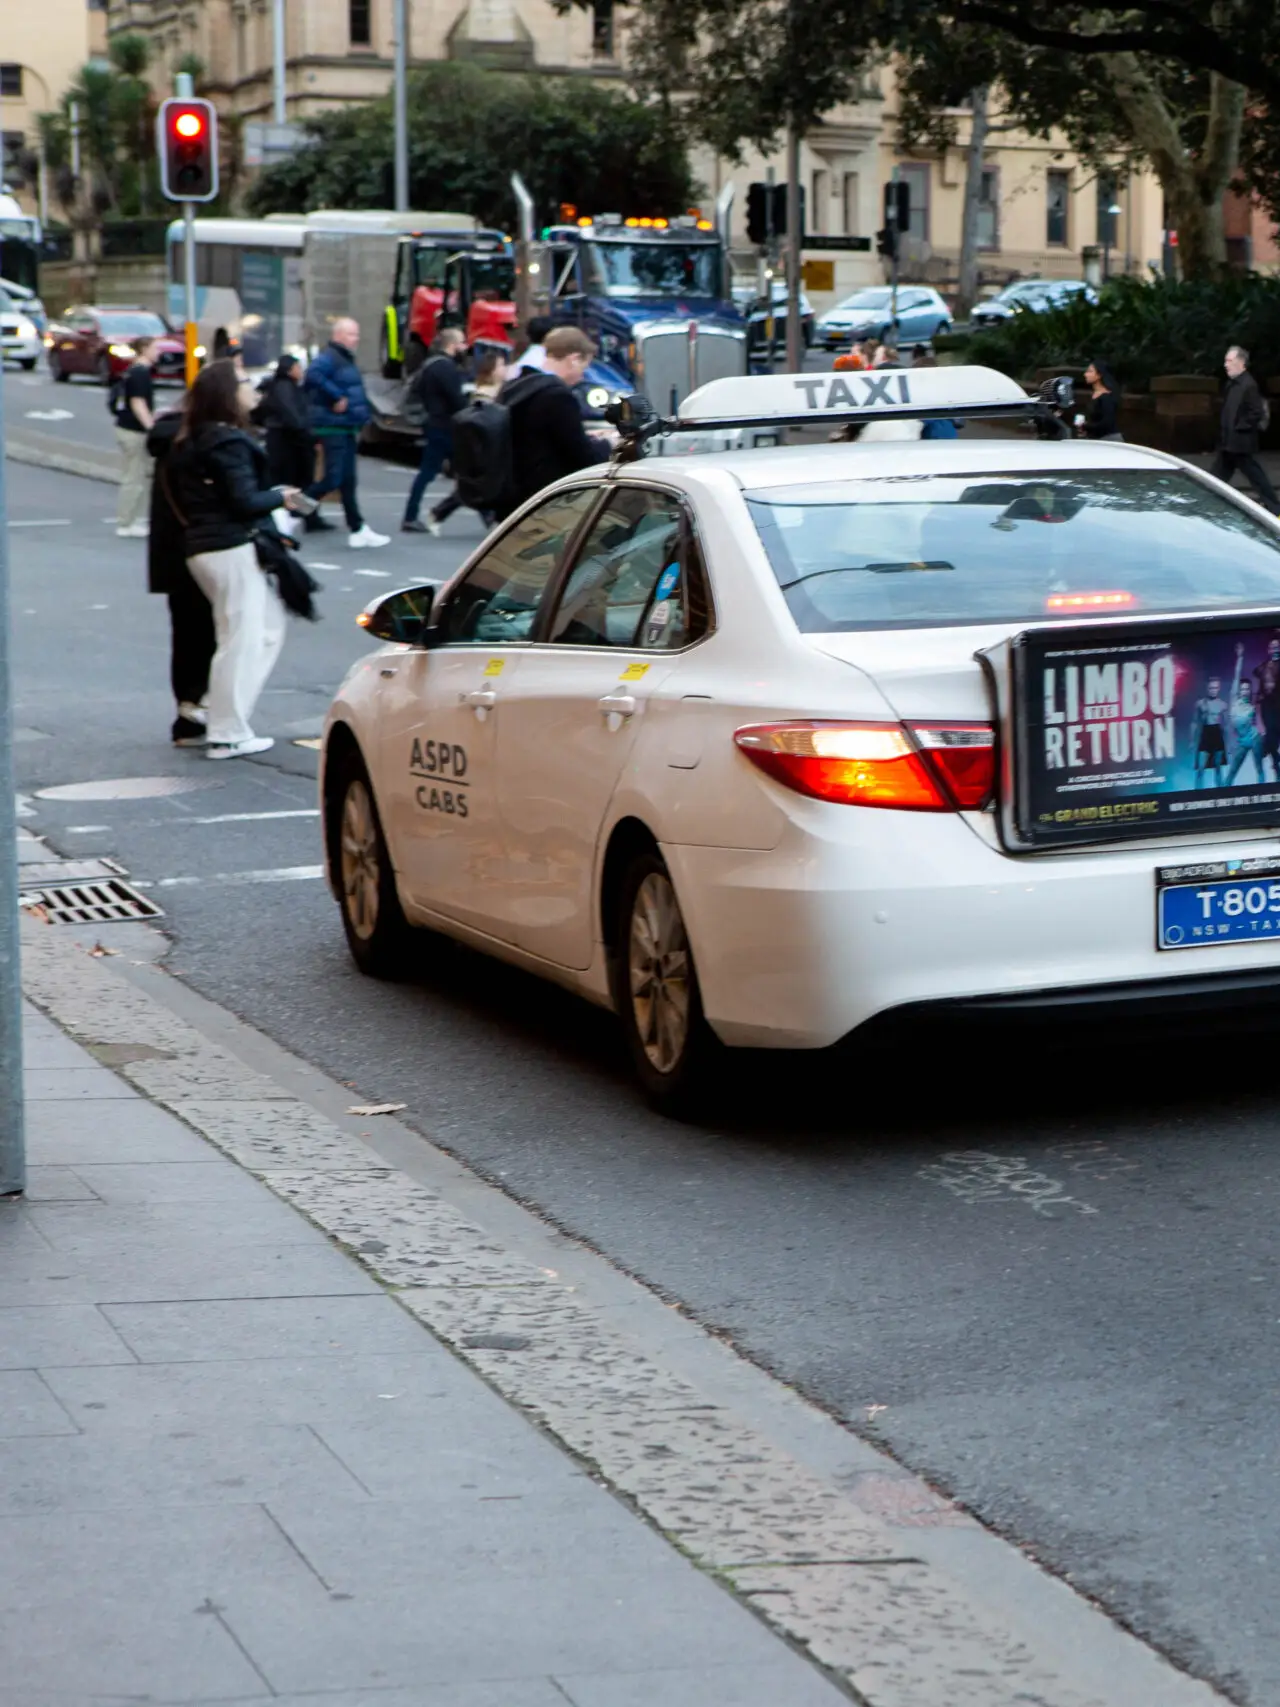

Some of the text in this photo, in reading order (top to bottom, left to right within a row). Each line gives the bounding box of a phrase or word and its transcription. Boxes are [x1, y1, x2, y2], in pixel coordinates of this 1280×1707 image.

[793, 374, 912, 410] TAXI
[1044, 654, 1175, 725] LIMBO
[410, 737, 467, 778] ASPD
[1044, 716, 1175, 770] RETURN
[416, 785, 469, 818] CABS
[1191, 923, 1231, 936] NSW
